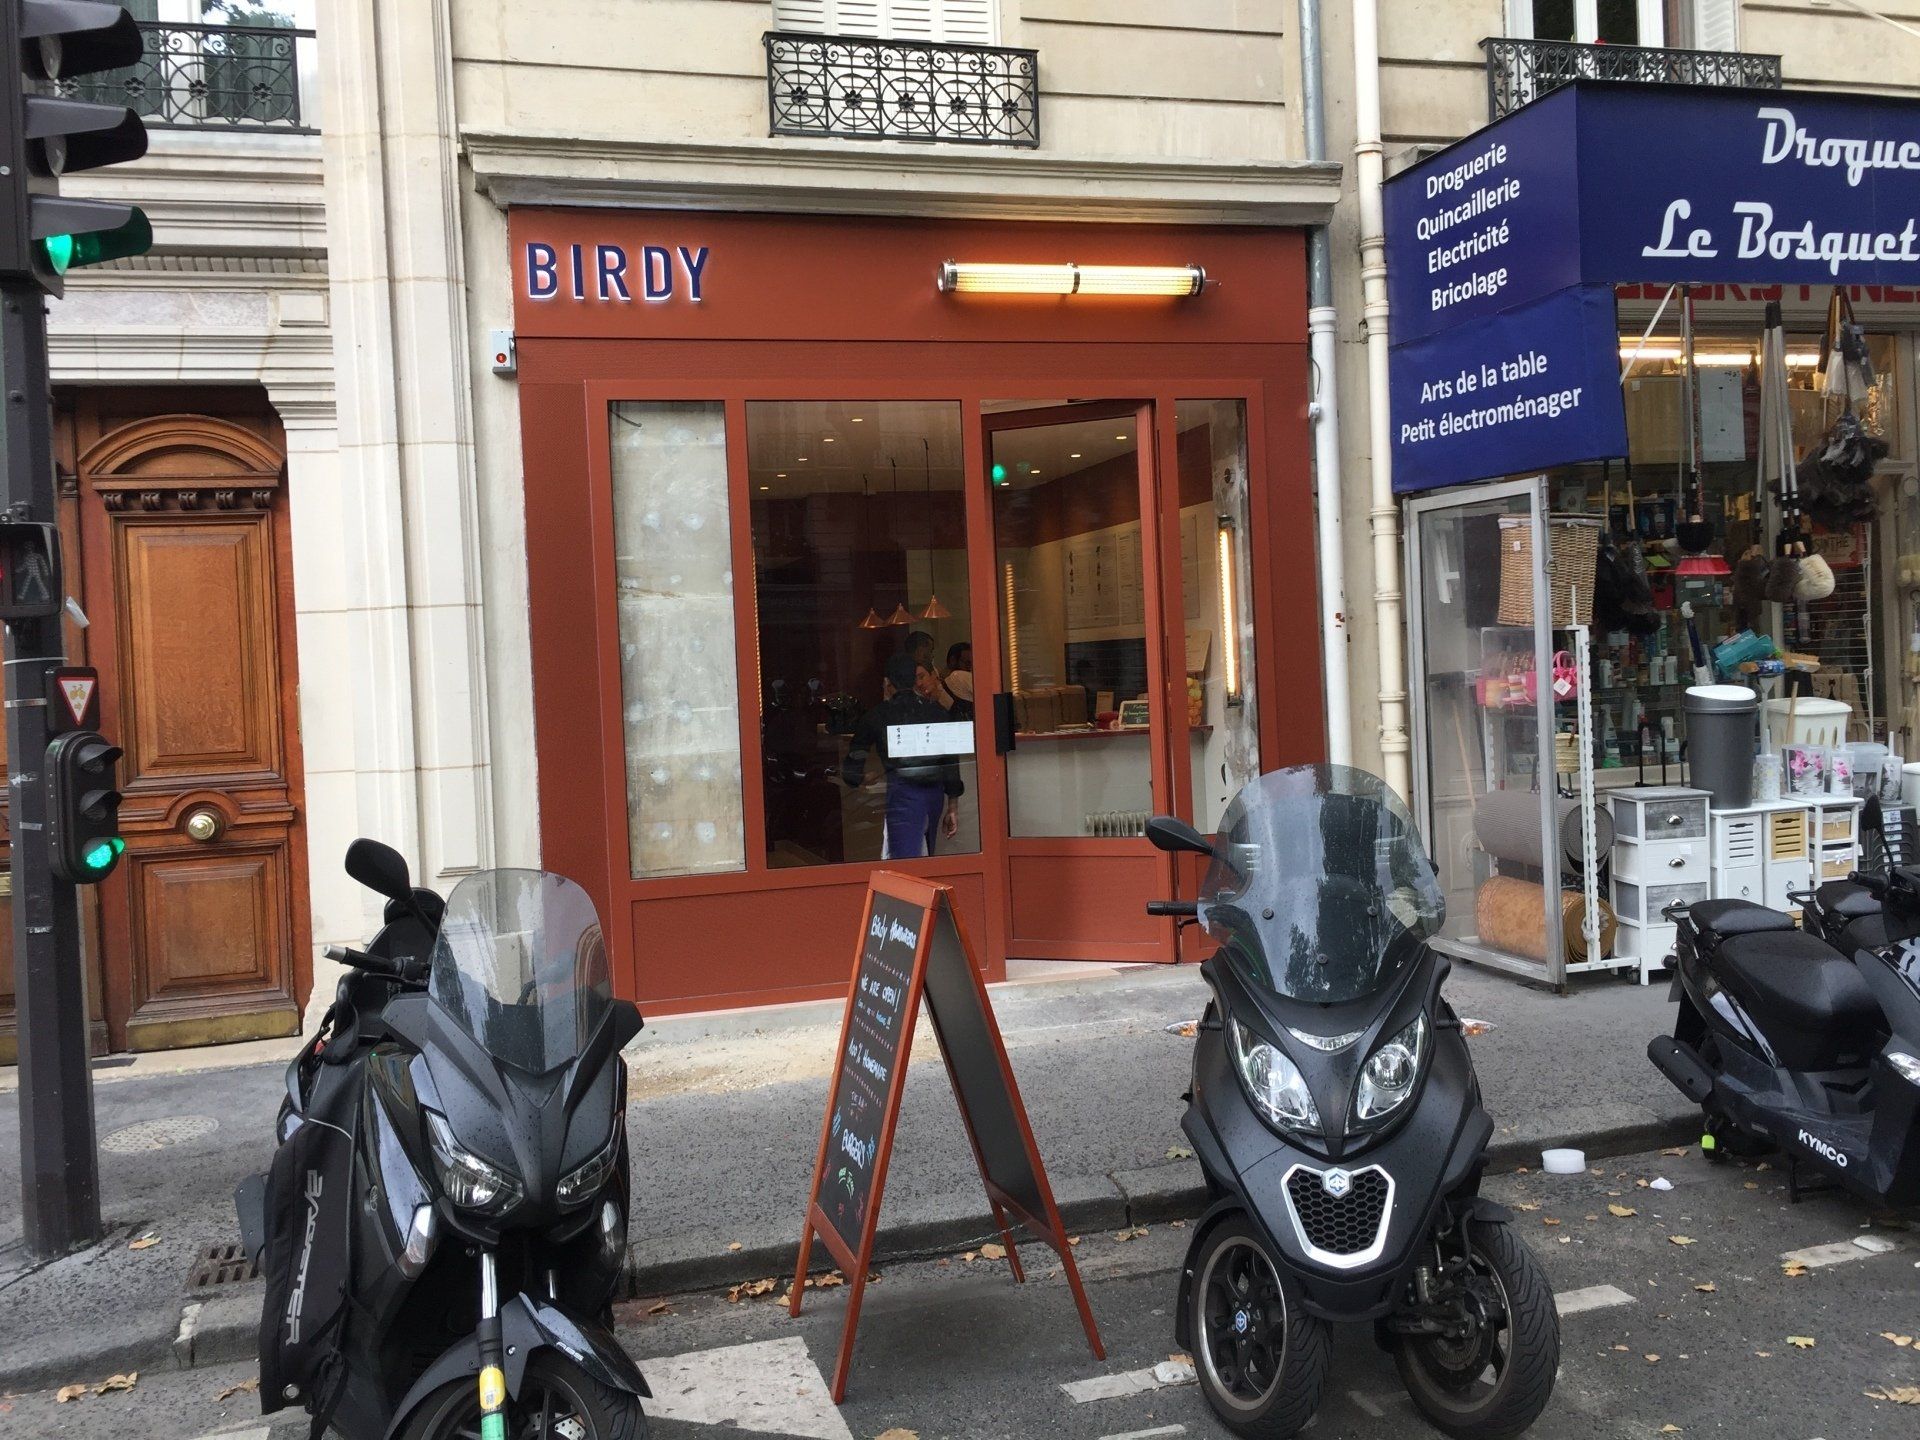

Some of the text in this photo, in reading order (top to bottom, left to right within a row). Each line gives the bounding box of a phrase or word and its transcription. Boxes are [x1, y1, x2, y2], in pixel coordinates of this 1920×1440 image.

[1426, 143, 1508, 200] Droguerie
[1416, 177, 1521, 241] Quincaillerie
[1641, 199, 1920, 276] Le Bosquet
[526, 242, 710, 302] BIRDY
[1428, 218, 1510, 274] Electricité
[1431, 267, 1508, 312] Bricolage
[1420, 350, 1548, 404] Arts de la table
[1400, 387, 1583, 445] Petit électroménager
[1798, 1129, 1848, 1168] KYMCO
